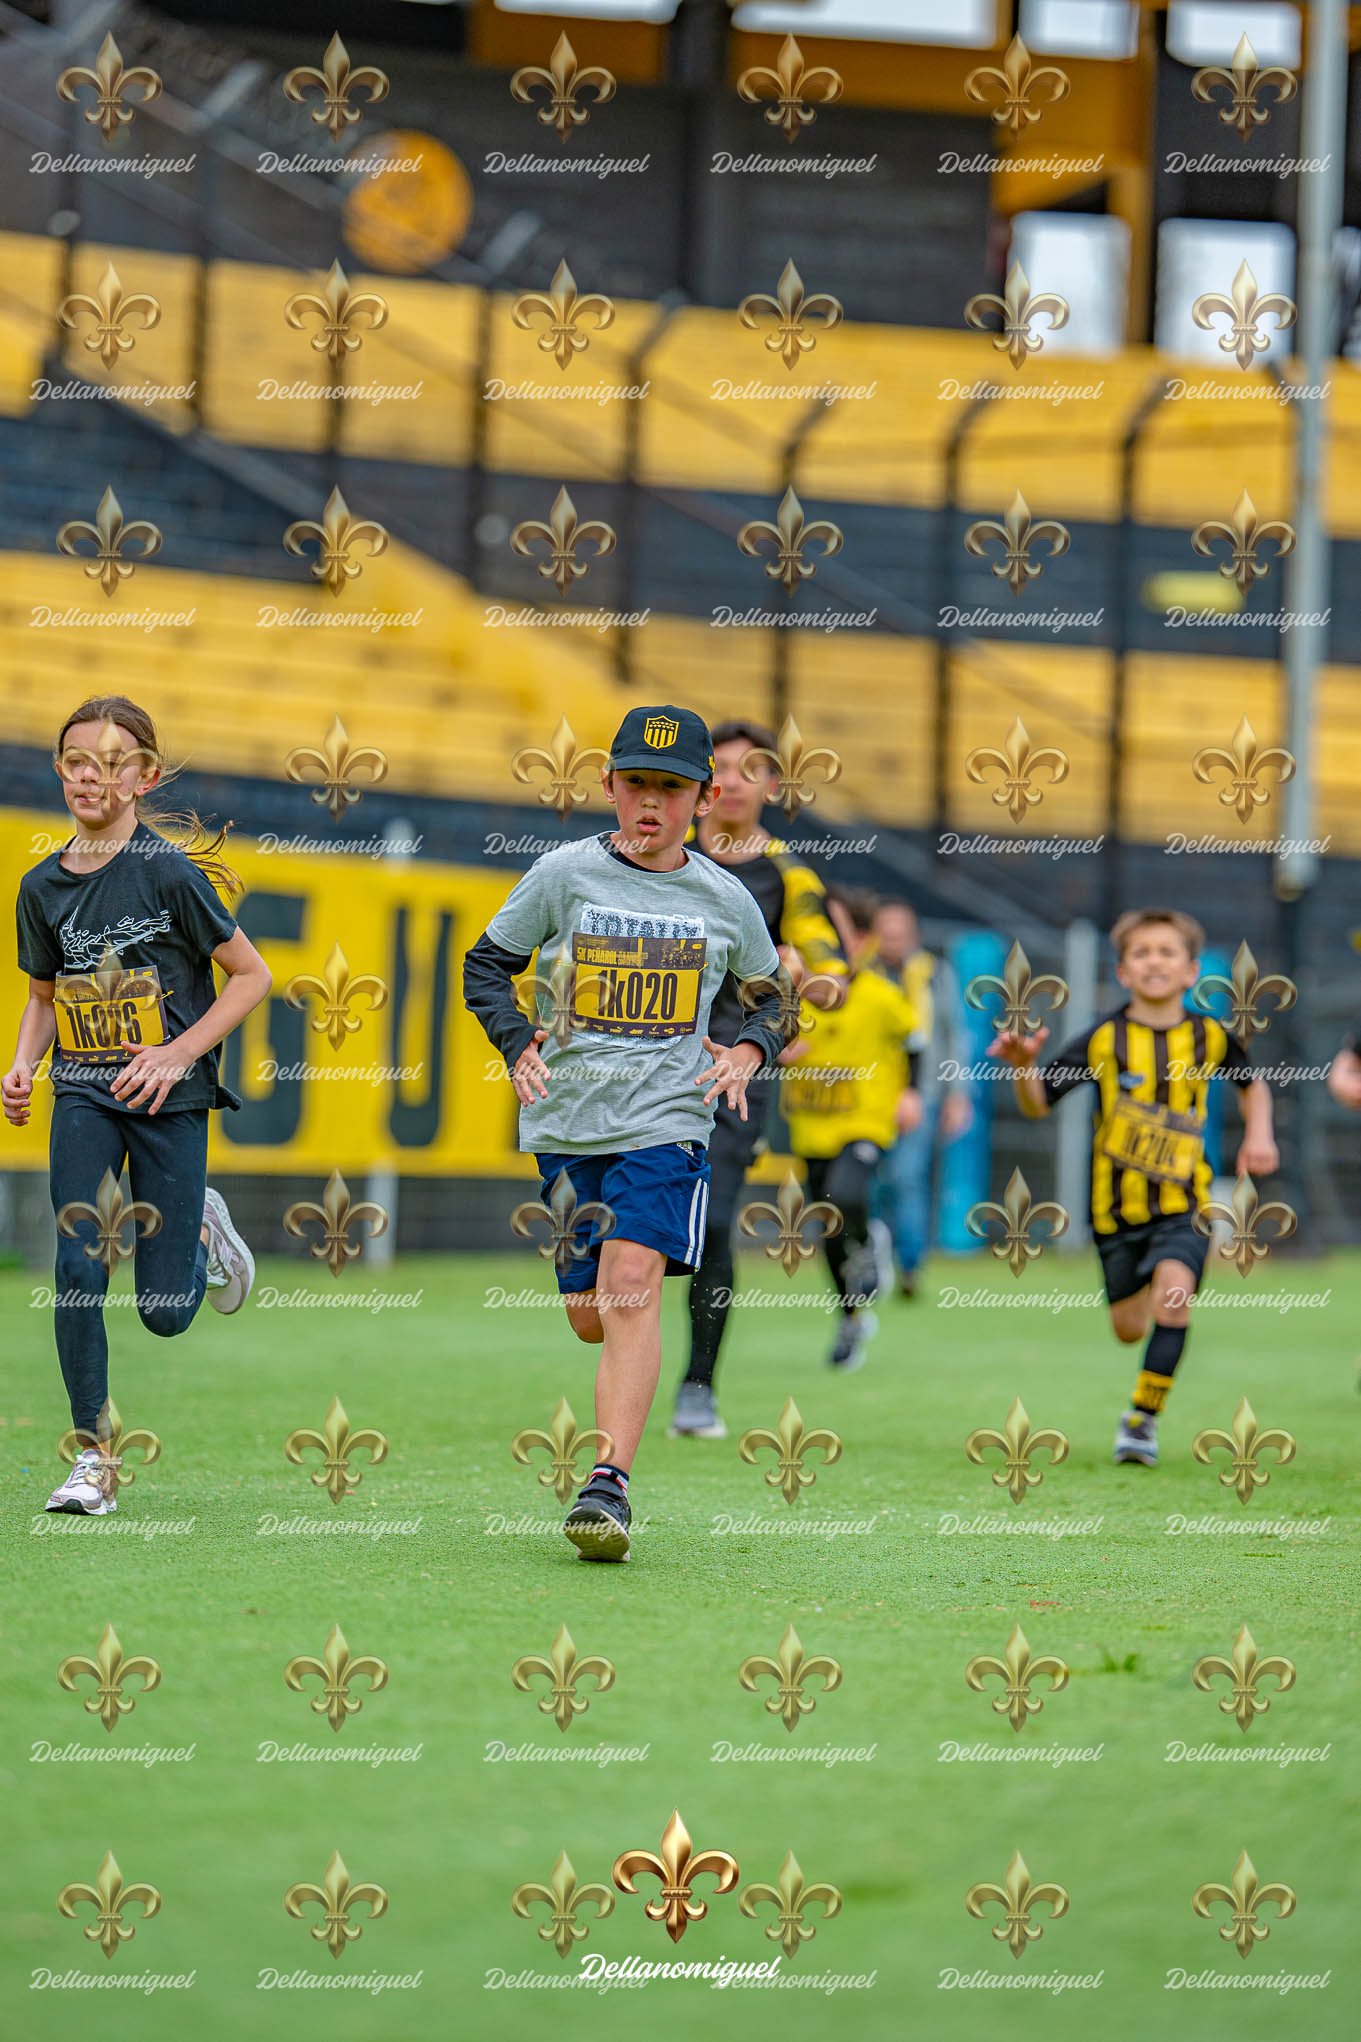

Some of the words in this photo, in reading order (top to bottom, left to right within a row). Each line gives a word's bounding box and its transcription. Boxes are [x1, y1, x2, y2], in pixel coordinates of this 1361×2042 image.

[220, 889, 520, 1148] GU
[597, 969, 678, 1021] 1k020
[66, 1001, 142, 1049] 1k026
